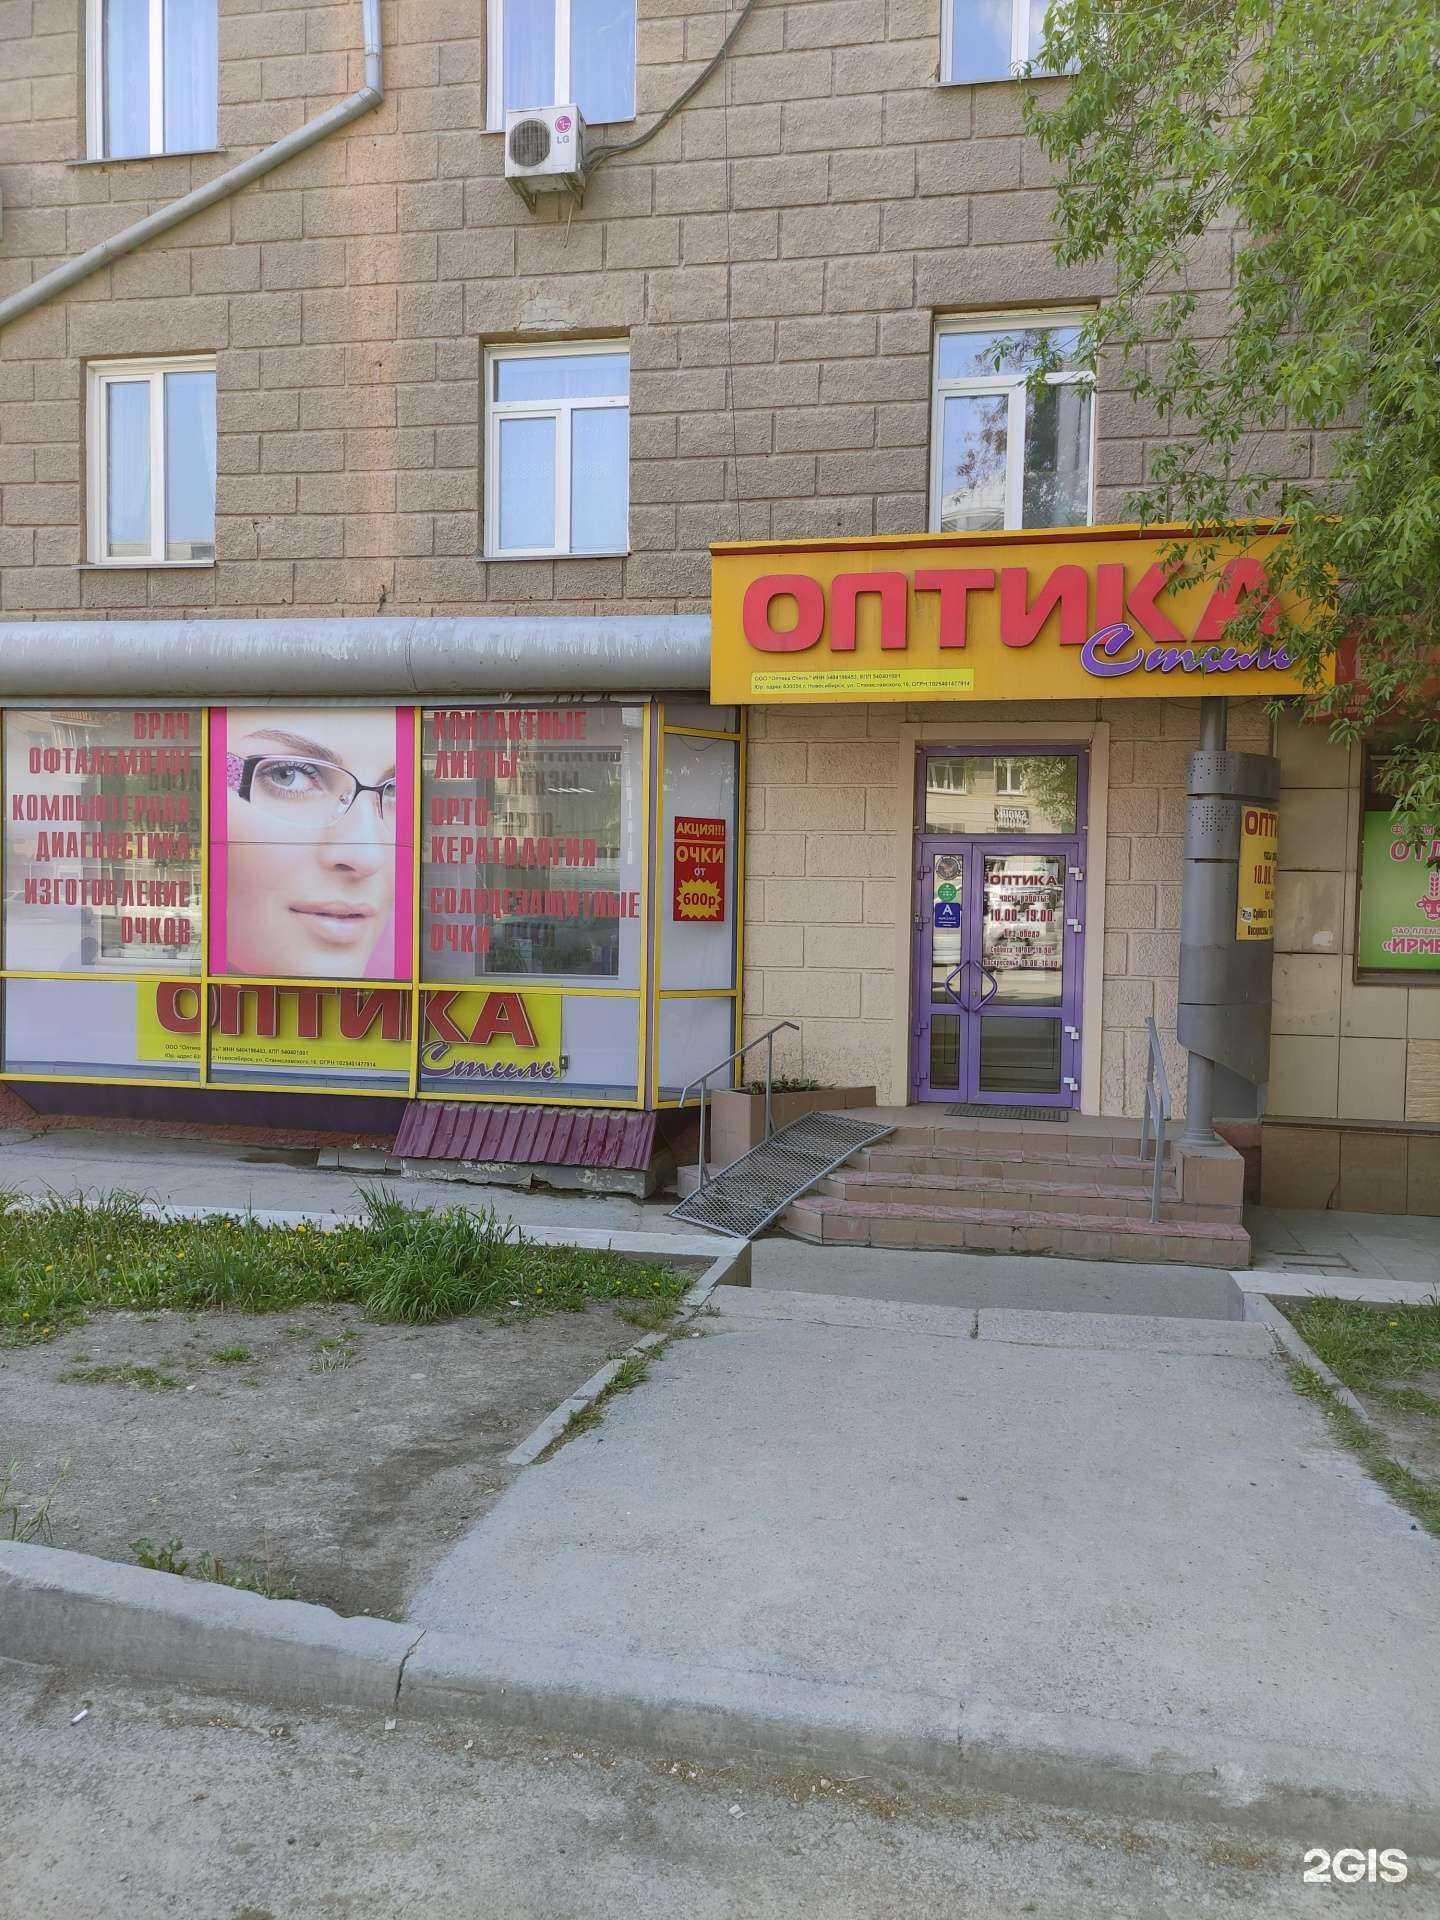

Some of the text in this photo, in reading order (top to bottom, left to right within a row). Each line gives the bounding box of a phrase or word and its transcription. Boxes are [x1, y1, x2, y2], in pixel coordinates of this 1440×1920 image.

[557, 134, 570, 144] LG
[742, 557, 1281, 653] ОПТИКА
[1080, 623, 1299, 677] Стиль
[134, 712, 190, 740] ВРАЧ
[433, 710, 586, 740] КОНТАКТНЫЕ
[29, 747, 193, 776] ОФТАЛЬМОЛОГ
[434, 750, 520, 779] ЛИНЗЫ
[12, 793, 191, 823] КОМПЬЮТЕРНАЯ
[675, 822, 725, 838] АКЦИЯ!!!
[35, 831, 191, 862] ДИАГНОСТИКА
[431, 836, 596, 867] КЕРАТОЛОГИЯ
[675, 845, 724, 864] ОЧКИ
[989, 875, 1058, 886] ОПТИКА
[683, 892, 716, 908] 600р
[120, 916, 191, 945] ОЧКОВ
[430, 923, 490, 952] ОЧКИ
[156, 981, 541, 1047] ОПТИКА
[421, 1039, 557, 1080] Стиль
